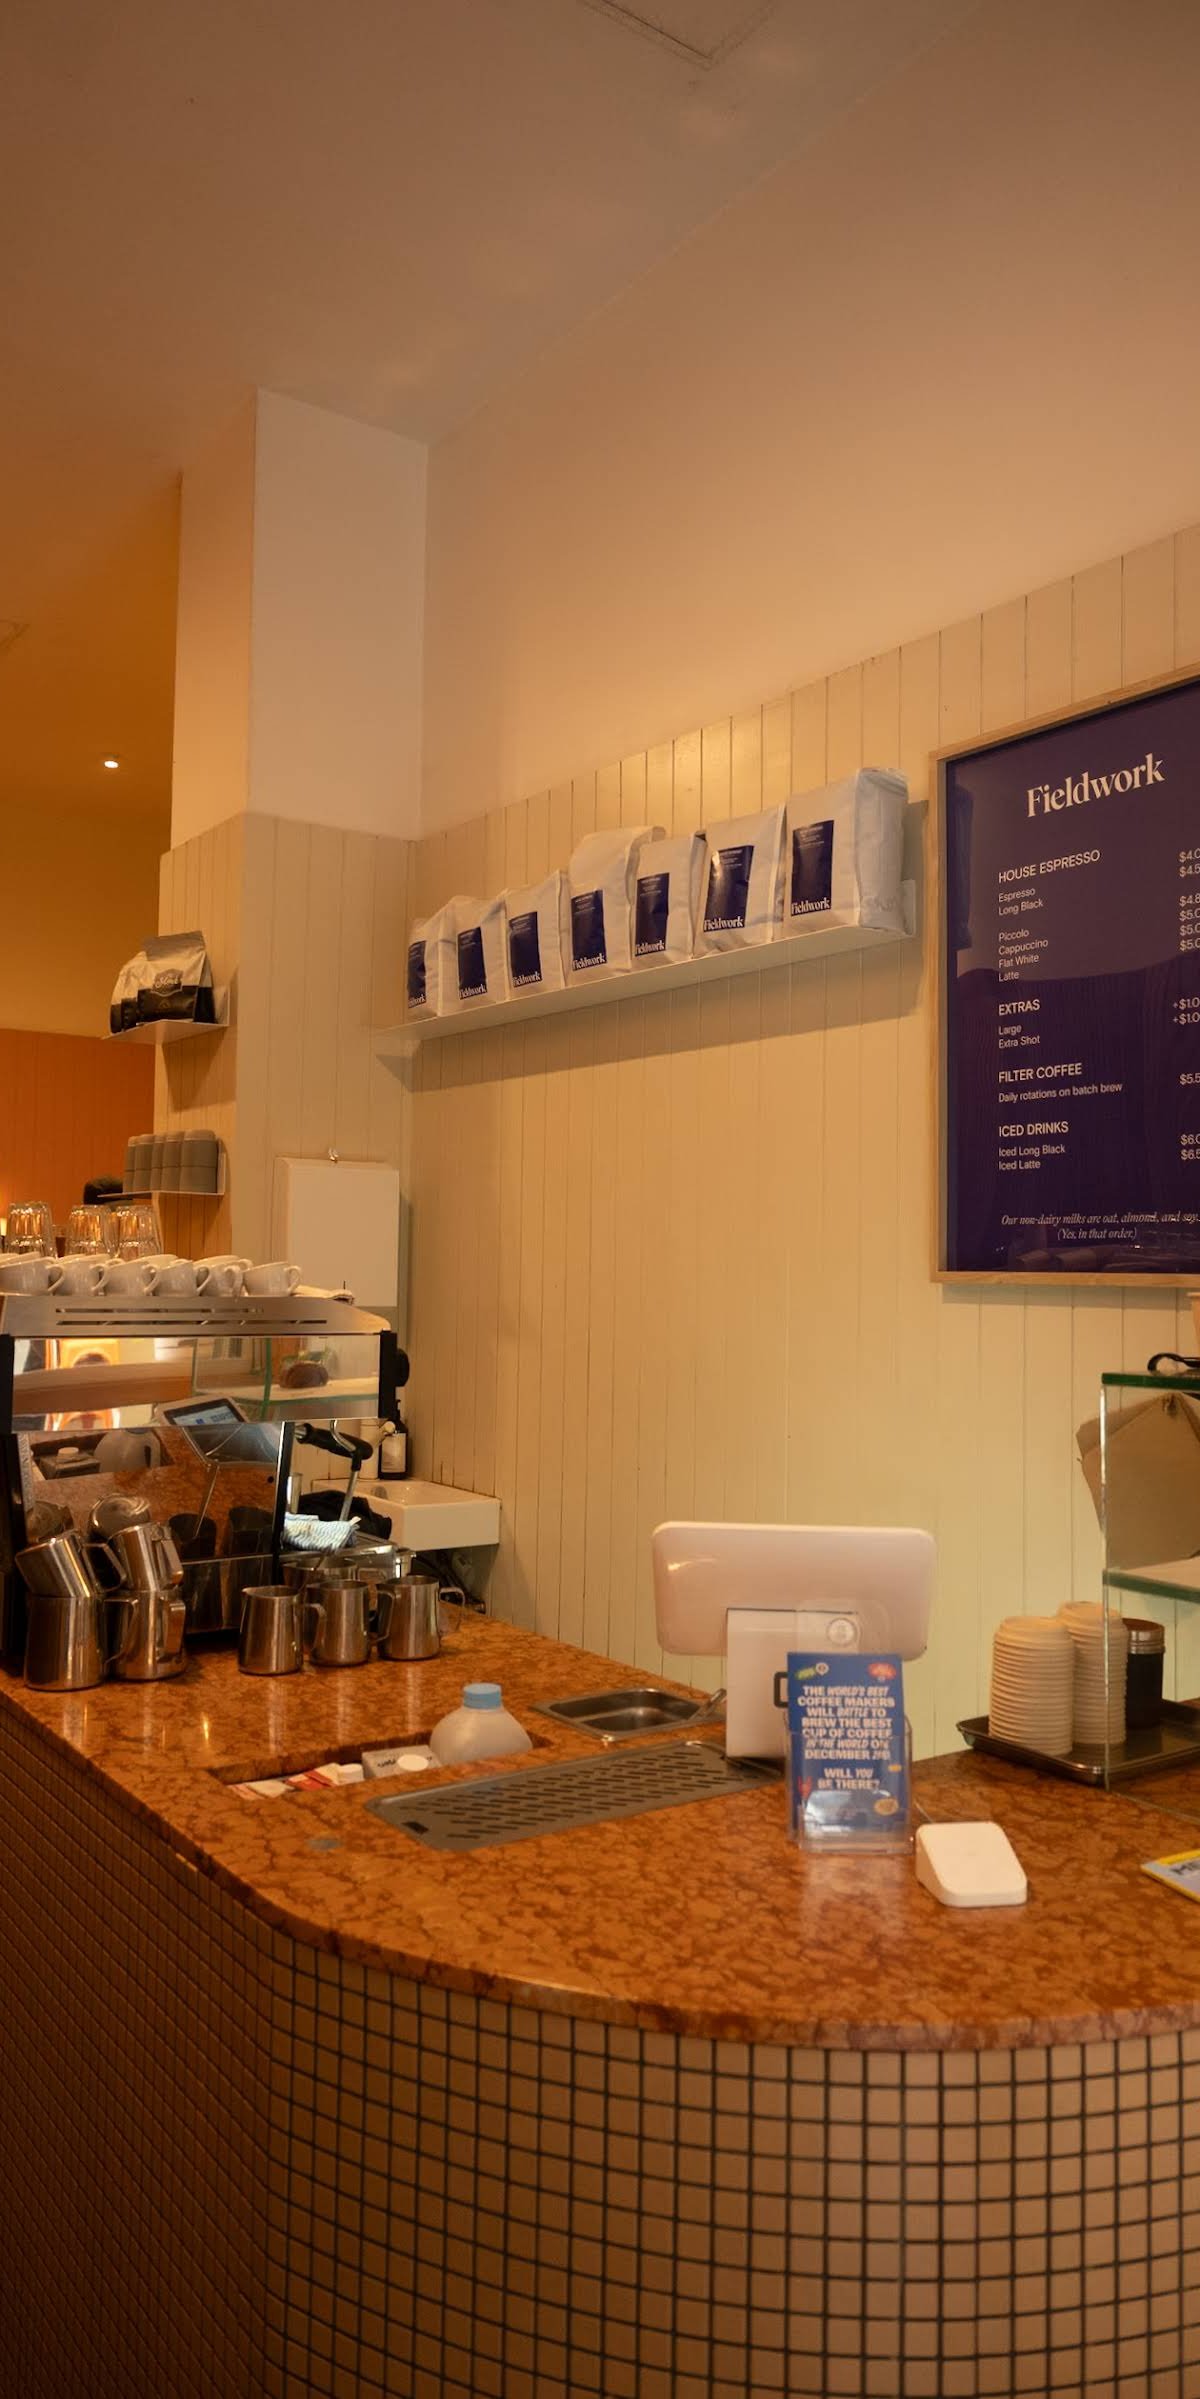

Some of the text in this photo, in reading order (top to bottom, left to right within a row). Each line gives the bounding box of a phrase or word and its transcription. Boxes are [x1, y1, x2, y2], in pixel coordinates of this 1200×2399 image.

[1027, 753, 1165, 818] Fieldwork
[999, 849, 1100, 884] HOUSE ESPRESSO
[998, 888, 1036, 903] Espresso
[791, 897, 831, 915] Fieldwork
[998, 899, 1044, 916] Long Black
[703, 915, 744, 931] Fieldwork
[998, 929, 1029, 942] Piccolo
[998, 939, 1049, 956] Cappuccino
[998, 954, 1040, 969] Flat White
[998, 971, 1020, 982] Latte
[998, 999, 1041, 1016] EXTRAS
[998, 1025, 1022, 1036] Large
[998, 1035, 1041, 1049] Extra Shot
[998, 1062, 1083, 1084] FILTER COFFEE
[998, 1083, 1123, 1103] Daily rotations on batch brew
[999, 1121, 1069, 1137] ICED DRINKS
[999, 1144, 1066, 1158] Iced Long Black
[999, 1159, 1041, 1170] Iced Latte
[1001, 1214, 1018, 1225] Our
[1019, 1213, 1061, 1227] non-dairy
[1062, 1212, 1087, 1224] milks
[1086, 1215, 1101, 1224] are
[1078, 1228, 1087, 1239] in
[1088, 1228, 1107, 1239] that
[803, 1686, 825, 1696] THE
[797, 1697, 896, 1707] COFFEE MAKERS
[806, 1707, 835, 1717] WILL
[871, 1708, 887, 1717] TO
[802, 1717, 893, 1728] BREW THE BEST
[802, 1728, 893, 1738] CUP OF COFFEE
[804, 1749, 870, 1760] DECEMBER
[823, 1767, 853, 1778] WILL
[835, 1778, 880, 1791] THERE?
